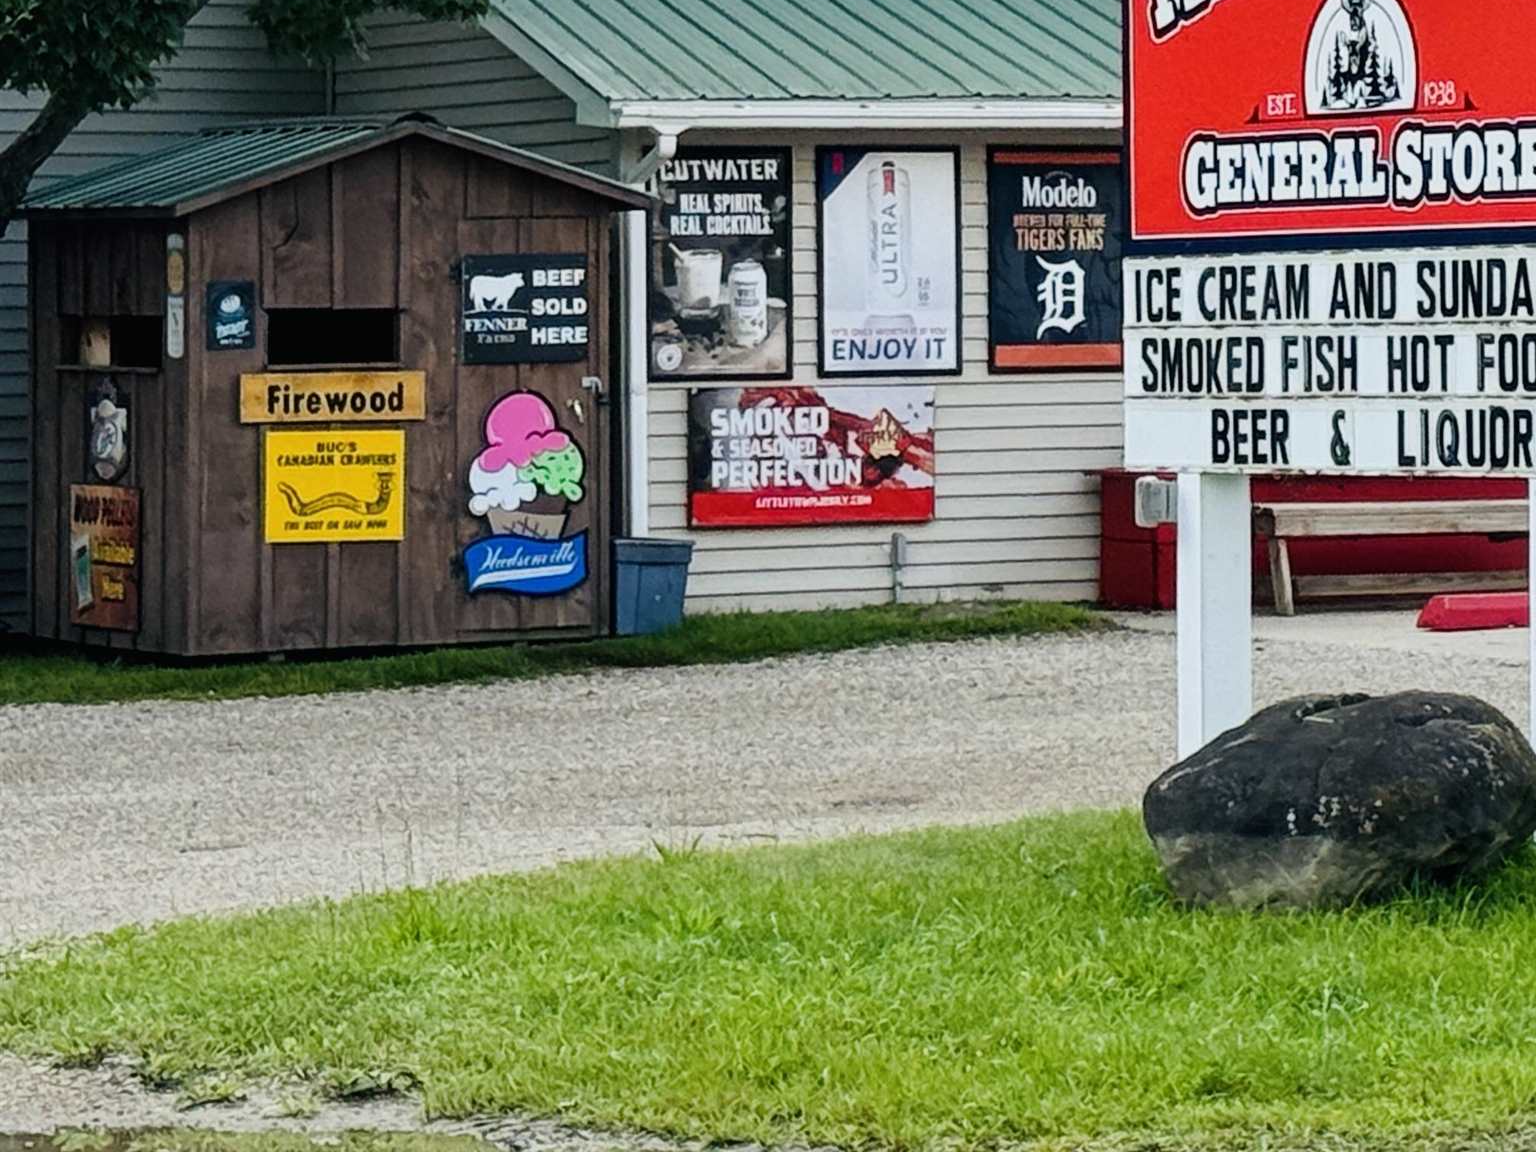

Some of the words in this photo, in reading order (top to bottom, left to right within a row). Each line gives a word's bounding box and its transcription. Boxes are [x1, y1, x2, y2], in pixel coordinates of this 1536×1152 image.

[1423, 80, 1457, 107] 1938
[660, 158, 779, 182] CUTWATER
[1185, 136, 1387, 210] GENERAL
[680, 193, 712, 214] REAL
[1022, 175, 1097, 208] Modelo
[670, 215, 704, 236] REAL
[881, 202, 899, 285] ULTRA
[1015, 228, 1066, 251] TIGERS
[1069, 228, 1105, 251] FANS
[531, 268, 586, 287] BEEF
[1135, 266, 1182, 323] ICE
[1197, 263, 1311, 322] CREAM
[1328, 261, 1397, 320] AND
[531, 297, 588, 316] SOLD
[464, 317, 529, 333] FENNER
[530, 326, 589, 345] HERE
[832, 338, 918, 361] ENJOY
[925, 337, 947, 360] IT
[1141, 335, 1265, 394] SMOKED
[1281, 335, 1359, 393] FISH
[1386, 334, 1455, 393] HOT
[267, 381, 404, 415] Firewood
[710, 406, 831, 437] SMOKED
[710, 437, 724, 458] &
[729, 436, 818, 458] SEASONED
[1211, 408, 1290, 465] BEER
[1330, 408, 1352, 467] &
[1397, 405, 1534, 471] LIQUOR
[711, 457, 863, 489] PERFECTION
